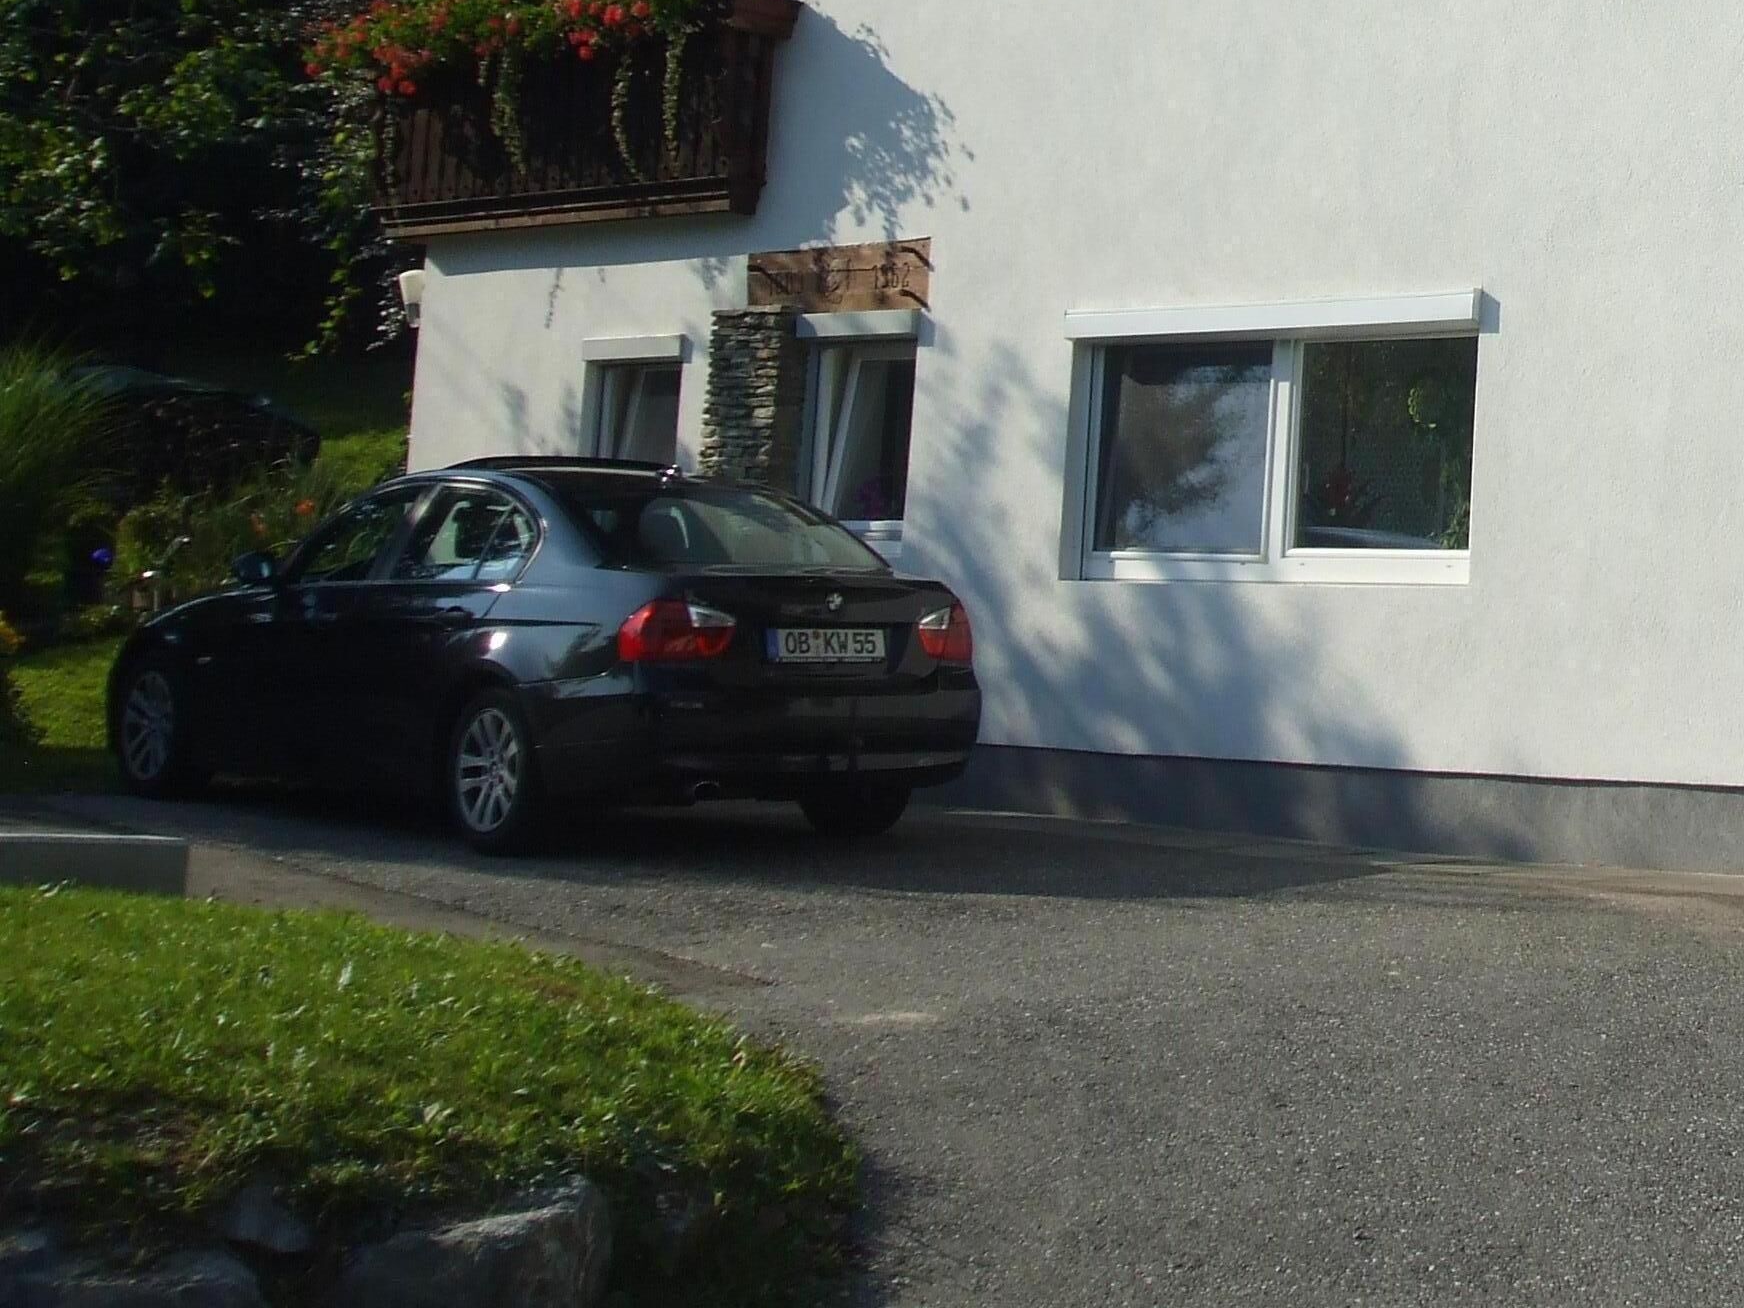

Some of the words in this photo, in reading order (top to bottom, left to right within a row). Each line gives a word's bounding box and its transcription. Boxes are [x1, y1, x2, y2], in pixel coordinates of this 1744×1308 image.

[785, 631, 810, 654] OB
[823, 631, 849, 654] KW
[852, 631, 876, 654] 55
